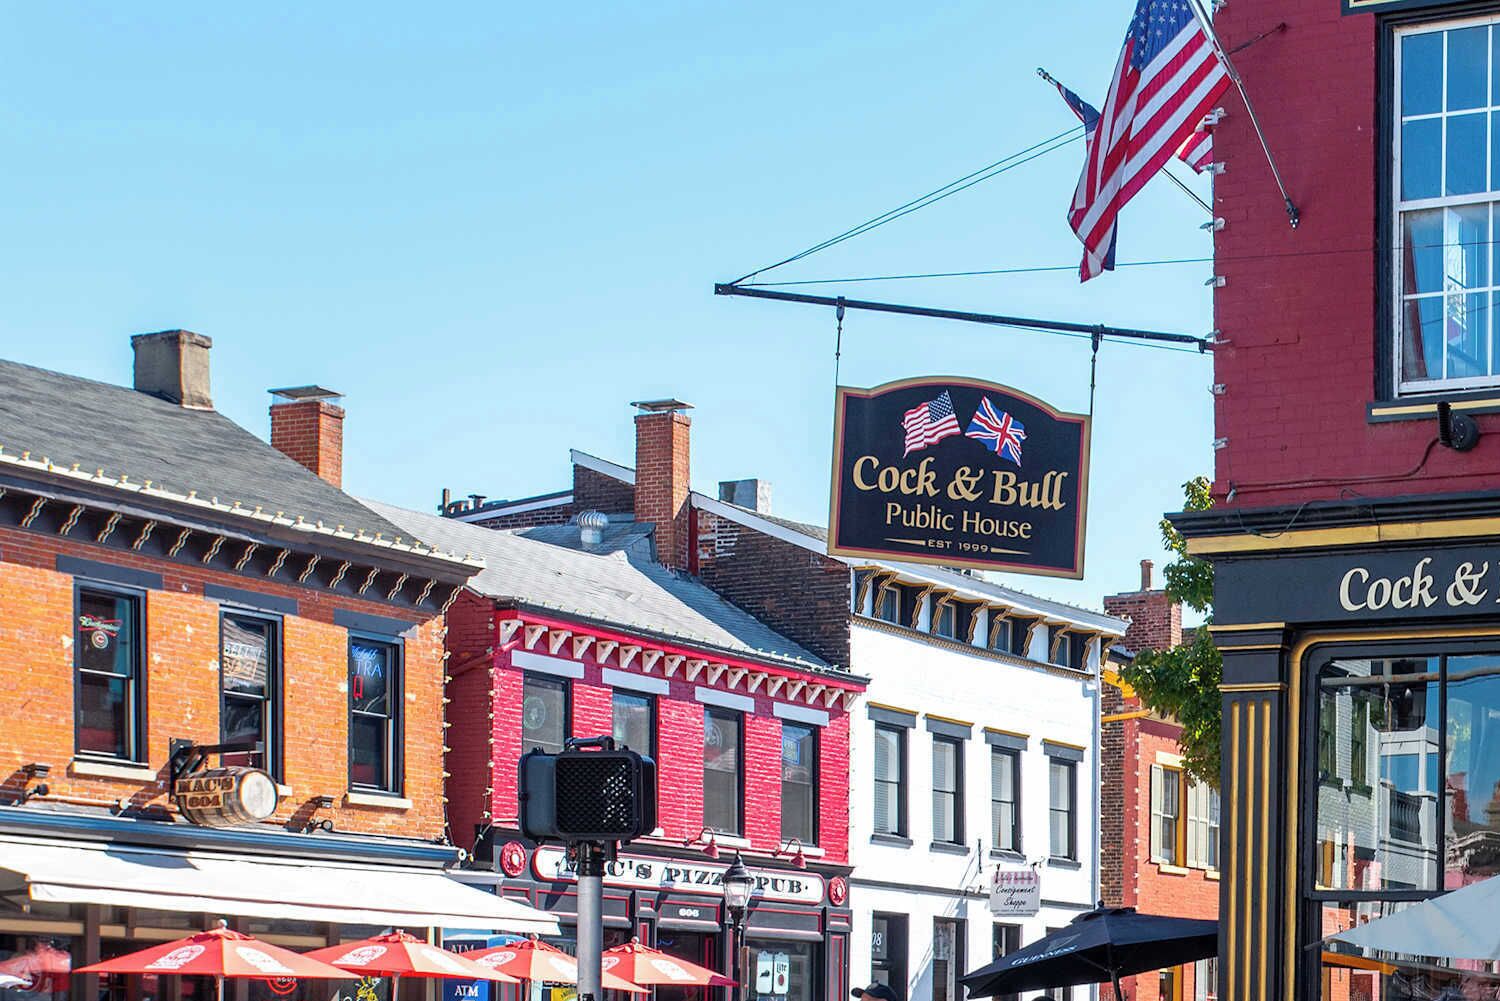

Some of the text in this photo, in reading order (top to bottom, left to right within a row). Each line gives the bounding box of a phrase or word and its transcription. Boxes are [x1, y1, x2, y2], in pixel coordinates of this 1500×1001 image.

[853, 455, 1068, 511] Cock & Bull
[886, 502, 1033, 540] Public House
[927, 539, 989, 553] EST 1999
[1340, 557, 1438, 612] Cock
[1446, 560, 1489, 608] &
[178, 777, 234, 793] MAC'S
[562, 856, 802, 894] MC'S PIZZ PUB
[454, 985, 479, 998] ATM
